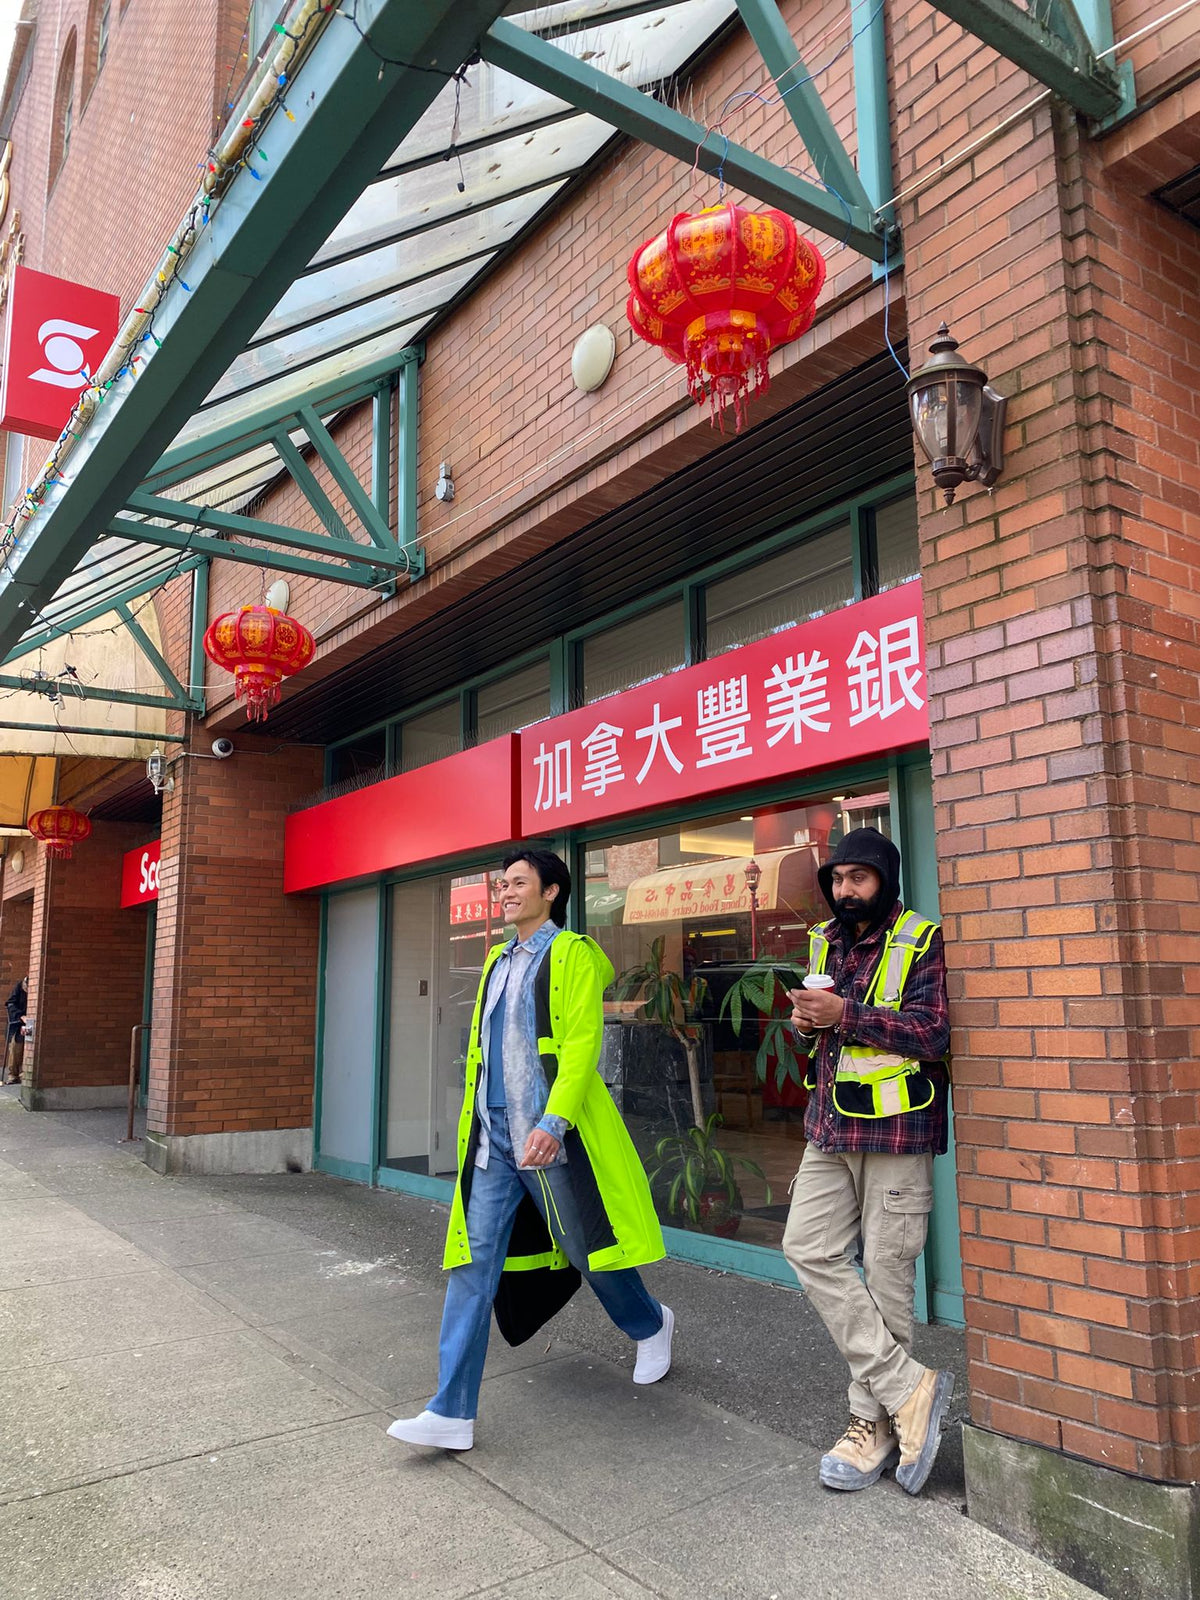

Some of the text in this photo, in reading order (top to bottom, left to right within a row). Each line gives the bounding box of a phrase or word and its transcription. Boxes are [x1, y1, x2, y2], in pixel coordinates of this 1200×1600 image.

[533, 615, 925, 812] 加拿大豐業銀
